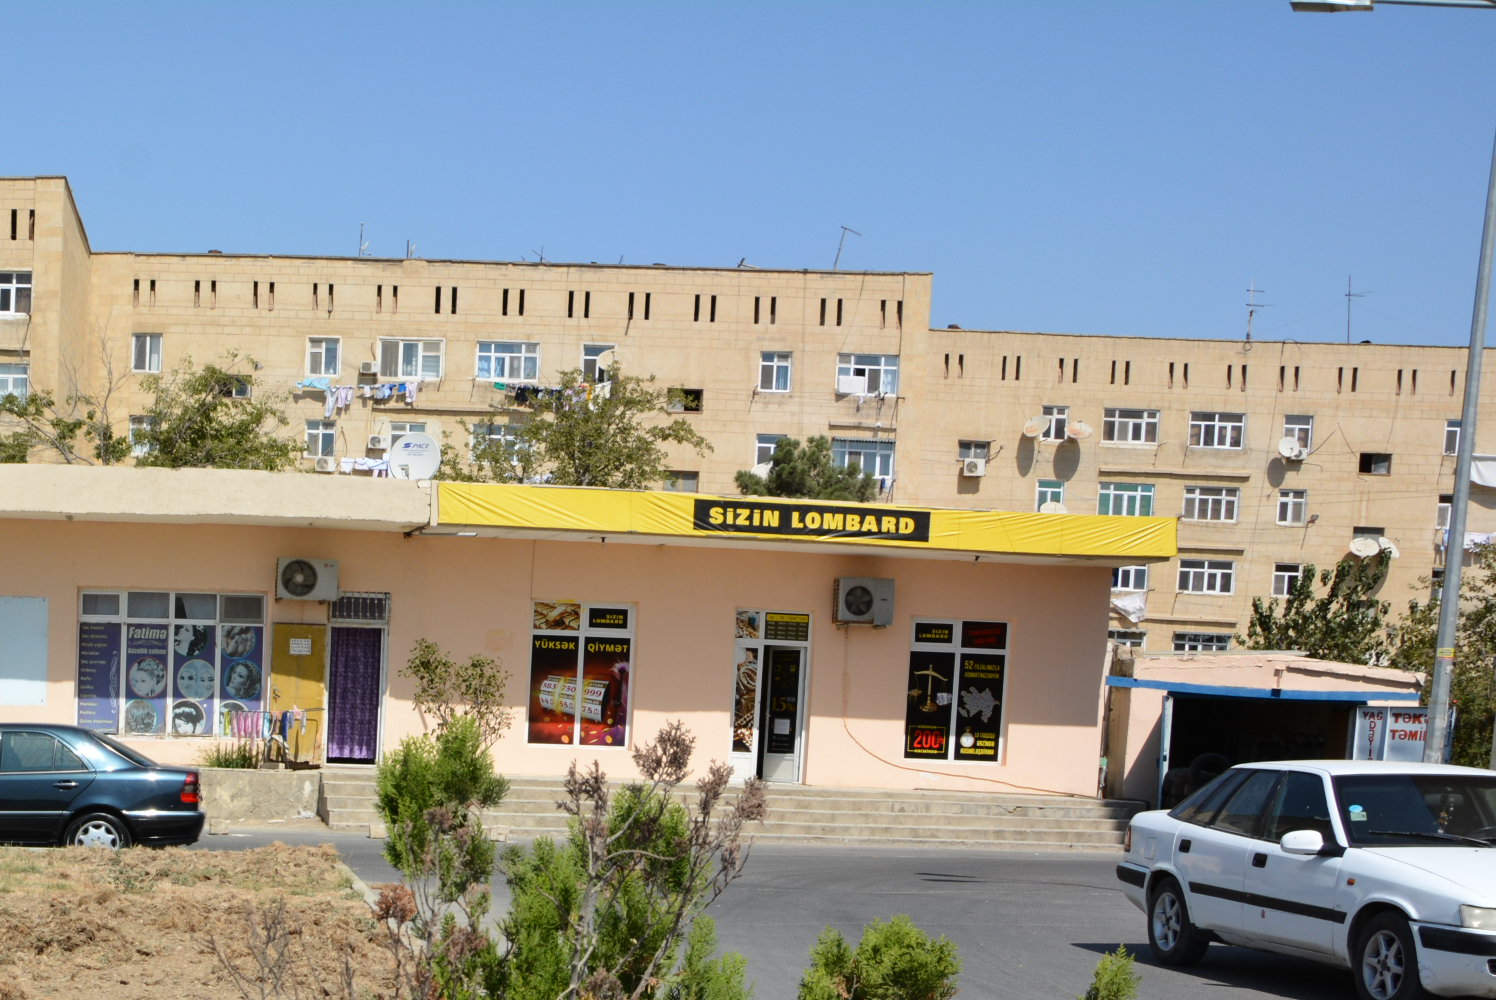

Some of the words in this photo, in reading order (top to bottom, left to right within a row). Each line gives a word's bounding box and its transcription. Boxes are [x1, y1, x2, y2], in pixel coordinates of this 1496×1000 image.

[791, 511, 916, 535] LOMBARD
[128, 626, 168, 640] Fatimə
[535, 639, 576, 650] YÜKSƏK
[587, 642, 629, 653] QİYMƏT
[964, 660, 974, 670] 52
[562, 685, 577, 693] 750
[584, 688, 602, 697] 999
